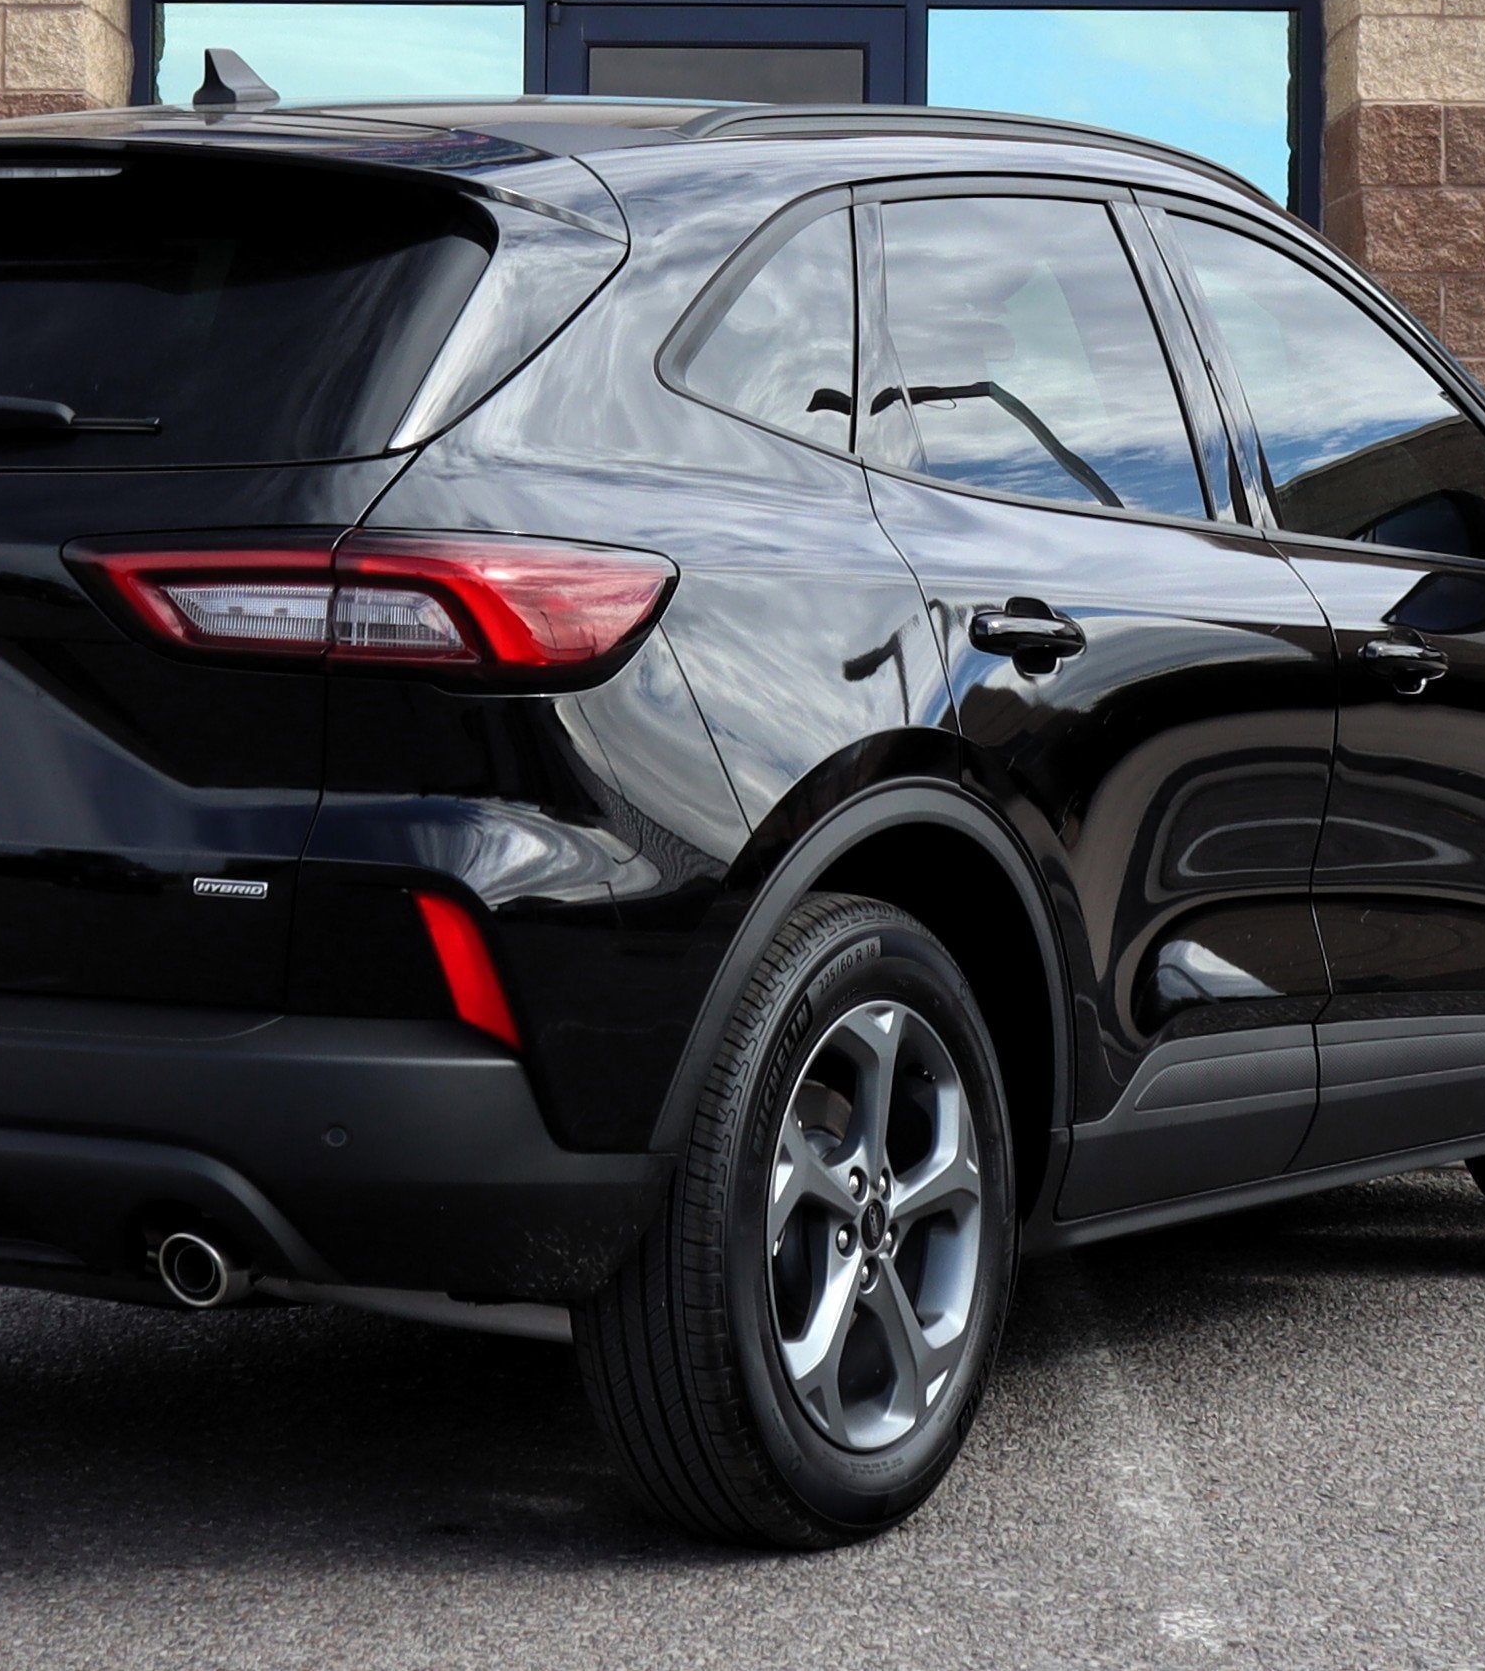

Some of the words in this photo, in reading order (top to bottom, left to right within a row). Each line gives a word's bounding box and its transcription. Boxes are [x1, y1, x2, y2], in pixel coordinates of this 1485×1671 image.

[197, 882, 263, 895] HYBRID
[818, 954, 853, 995] 225/60
[855, 948, 863, 964] R
[866, 943, 876, 958] 18
